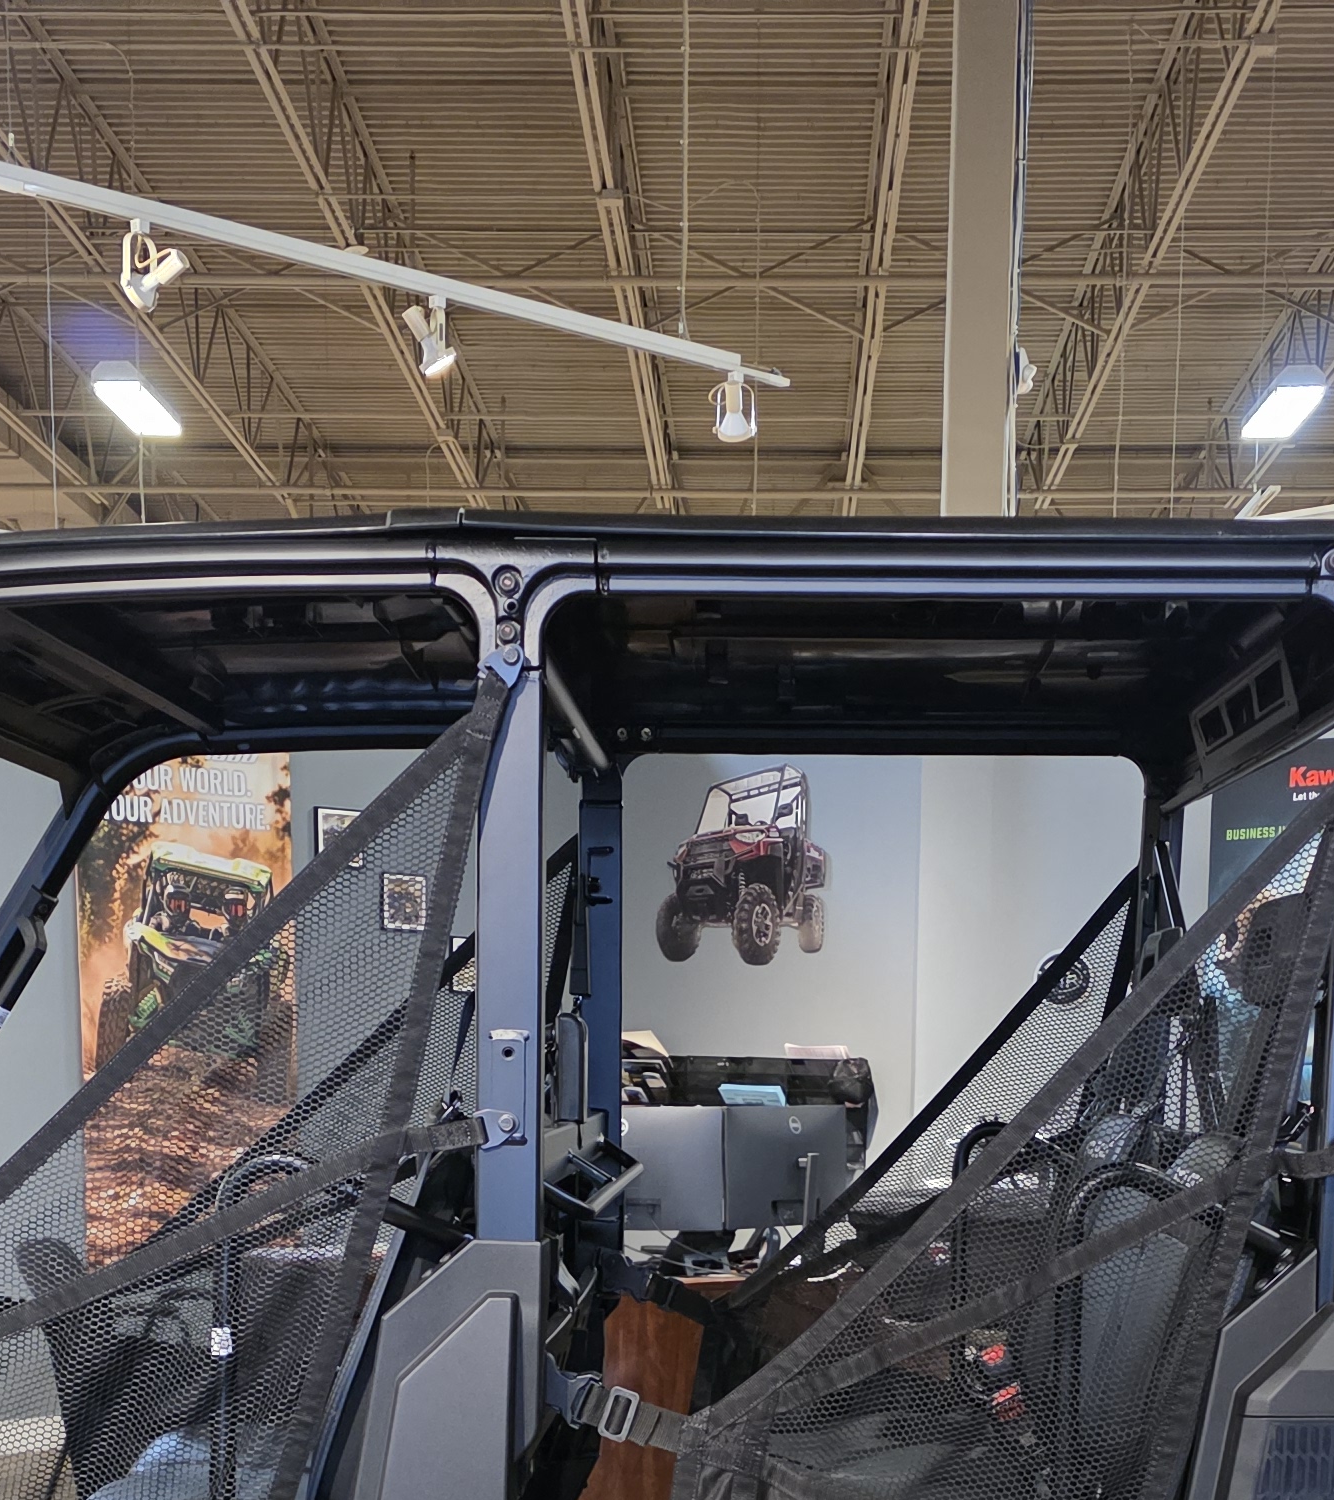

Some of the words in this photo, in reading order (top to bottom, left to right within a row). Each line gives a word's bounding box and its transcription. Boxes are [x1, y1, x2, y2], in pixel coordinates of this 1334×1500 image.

[132, 764, 173, 791] OUR
[179, 767, 252, 798] WORLD.
[1293, 792, 1307, 802] Let
[160, 800, 271, 831] ADVENTURE.
[1225, 825, 1276, 841] BUSINESS
